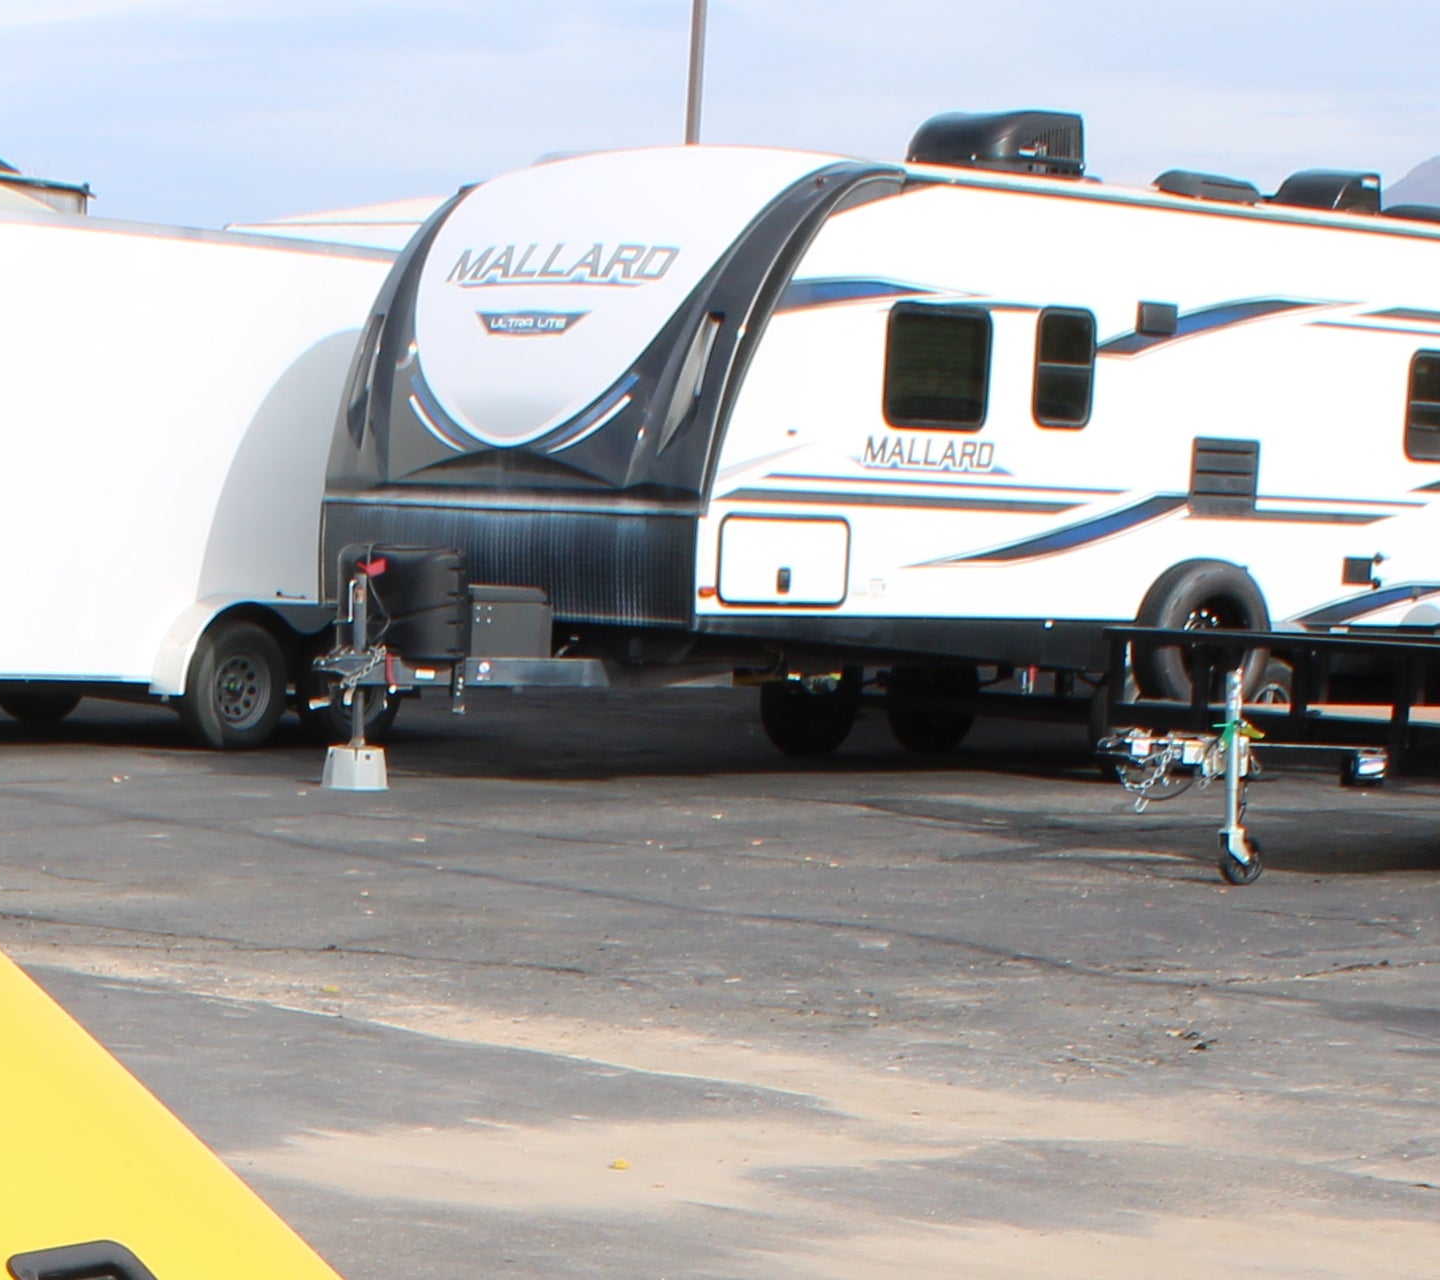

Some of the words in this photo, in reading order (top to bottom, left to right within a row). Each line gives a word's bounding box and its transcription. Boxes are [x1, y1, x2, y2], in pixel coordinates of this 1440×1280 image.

[445, 242, 681, 283] MALLARD
[489, 316, 534, 330] ULTRA
[536, 317, 568, 330] LITE
[863, 435, 995, 469] MALLARD
